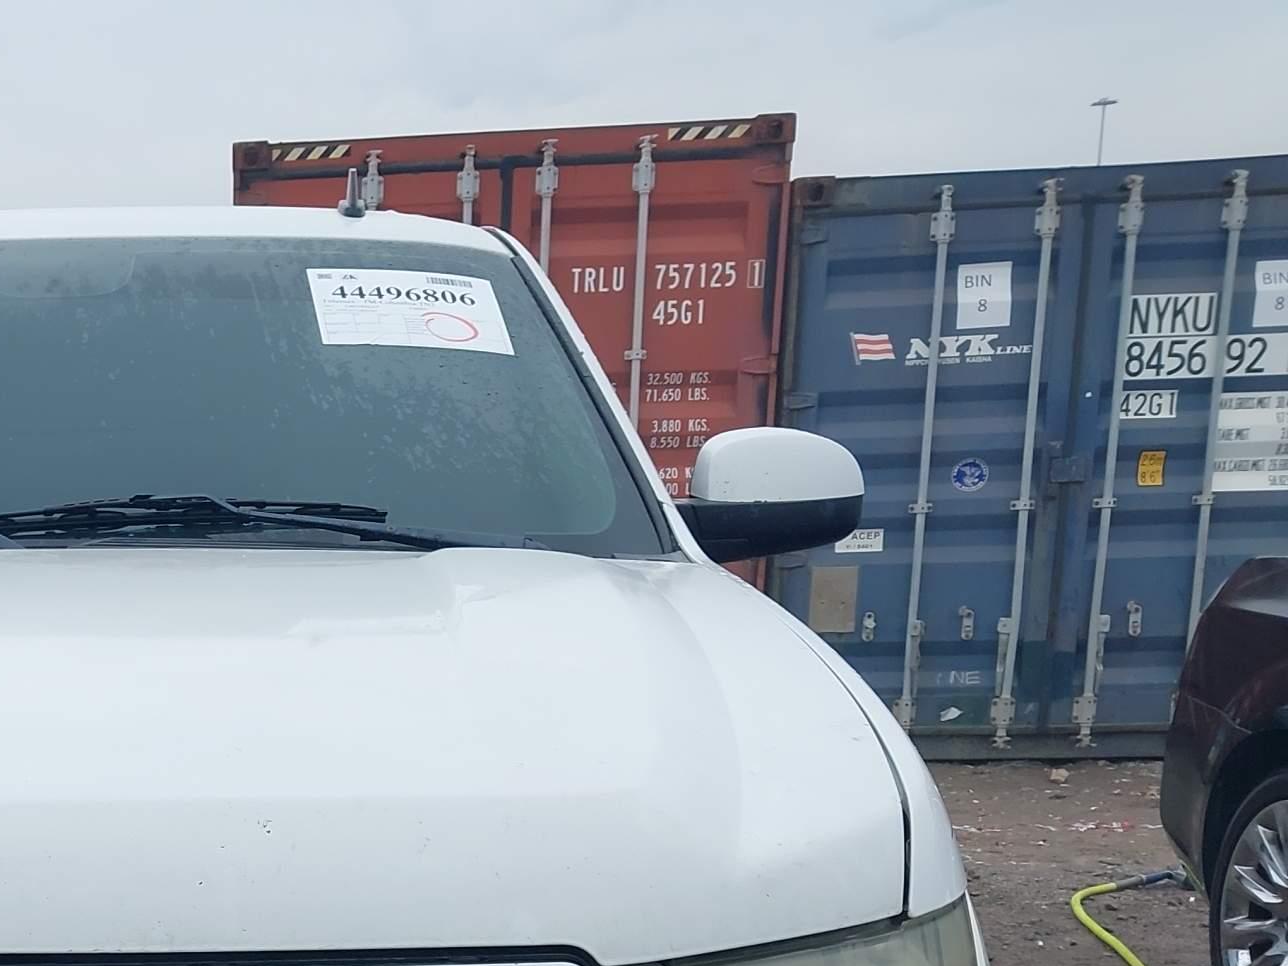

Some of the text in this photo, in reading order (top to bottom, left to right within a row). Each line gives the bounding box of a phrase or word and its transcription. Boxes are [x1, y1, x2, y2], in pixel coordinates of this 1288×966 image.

[572, 266, 625, 294] TRLU
[655, 261, 737, 290] 757125
[965, 273, 992, 289] BIN
[1262, 271, 1288, 285] BIN
[332, 285, 476, 306] 44496806
[1274, 295, 1285, 311] 8
[652, 299, 705, 325] 45G1
[977, 298, 988, 313] 8
[1129, 294, 1214, 334] NYKU
[905, 334, 1033, 359] NYK LINE
[647, 371, 712, 385] 32.500 KGS.
[646, 387, 710, 402] 71.650 LBS.
[1120, 391, 1176, 417] 42G1
[651, 418, 710, 433] 3.880 KGS.
[650, 436, 680, 448] 8.550
[851, 531, 881, 540] ACEP
